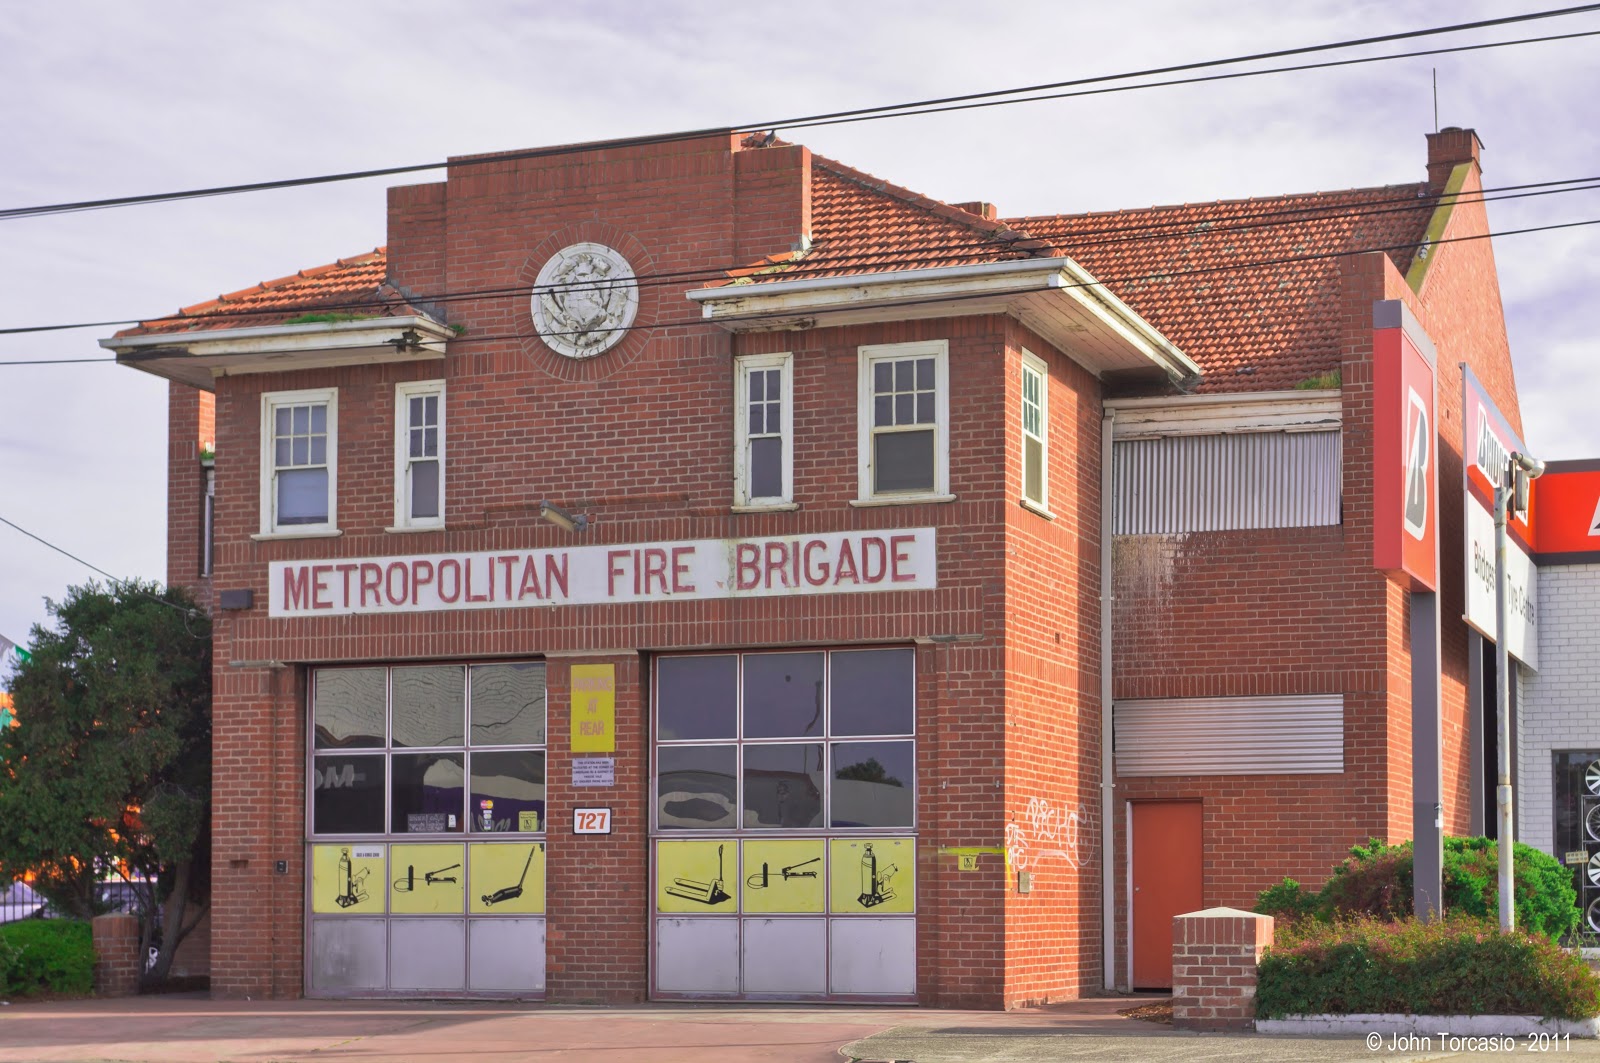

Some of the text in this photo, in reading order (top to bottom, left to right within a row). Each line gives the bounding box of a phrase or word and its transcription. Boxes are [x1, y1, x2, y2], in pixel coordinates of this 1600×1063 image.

[282, 534, 917, 612] METROPOLITAN FIRE BRIGADE
[1507, 573, 1518, 615] Tyre
[1519, 586, 1535, 626] Centre
[573, 676, 613, 693] PARKING
[587, 698, 599, 714] AT
[580, 720, 605, 736] REAR
[577, 812, 606, 829] 727
